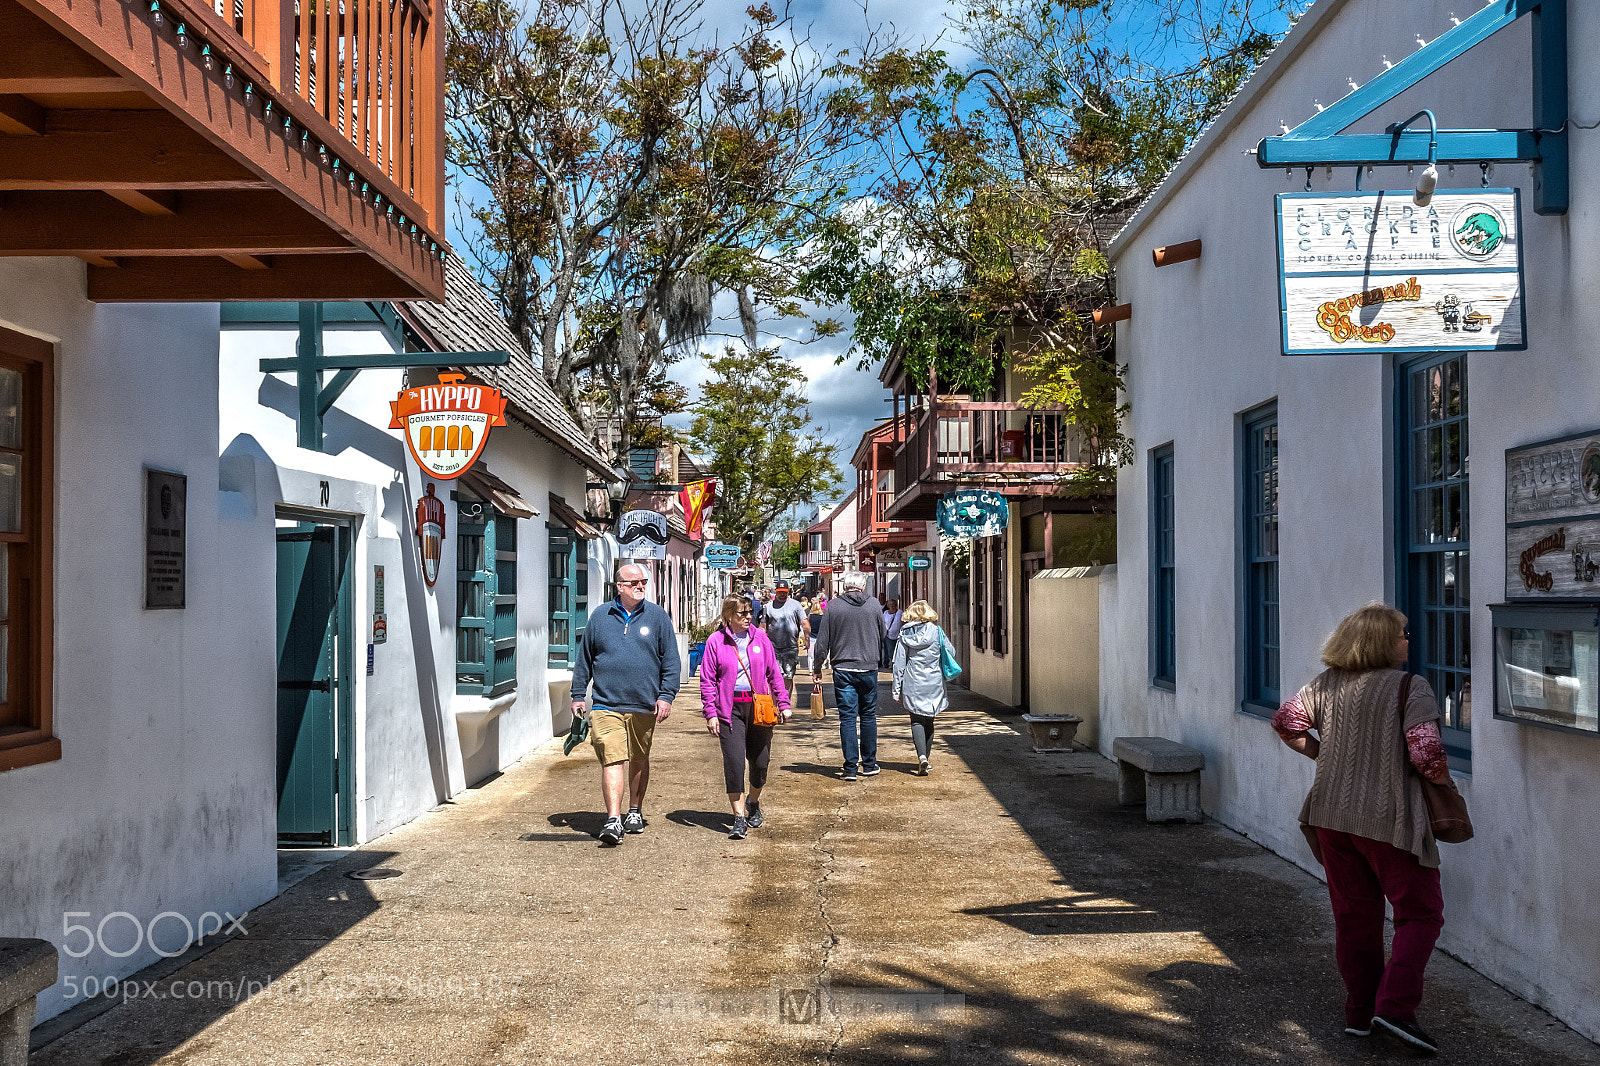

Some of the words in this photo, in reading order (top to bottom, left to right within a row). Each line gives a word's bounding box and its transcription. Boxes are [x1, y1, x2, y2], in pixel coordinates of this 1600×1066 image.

[1297, 205, 1440, 222] FLORIDA
[1297, 220, 1440, 237] CRACKER
[1298, 235, 1440, 252] CAFE
[1297, 254, 1341, 264] FLORIDA
[1400, 252, 1441, 262] CUISINE
[1318, 277, 1421, 326] Savannah
[1334, 315, 1396, 344] Sweets
[420, 386, 481, 411] HYPPO
[409, 414, 446, 425] GOURMET
[446, 414, 486, 423] POPSICLES
[320, 480, 330, 507] 70
